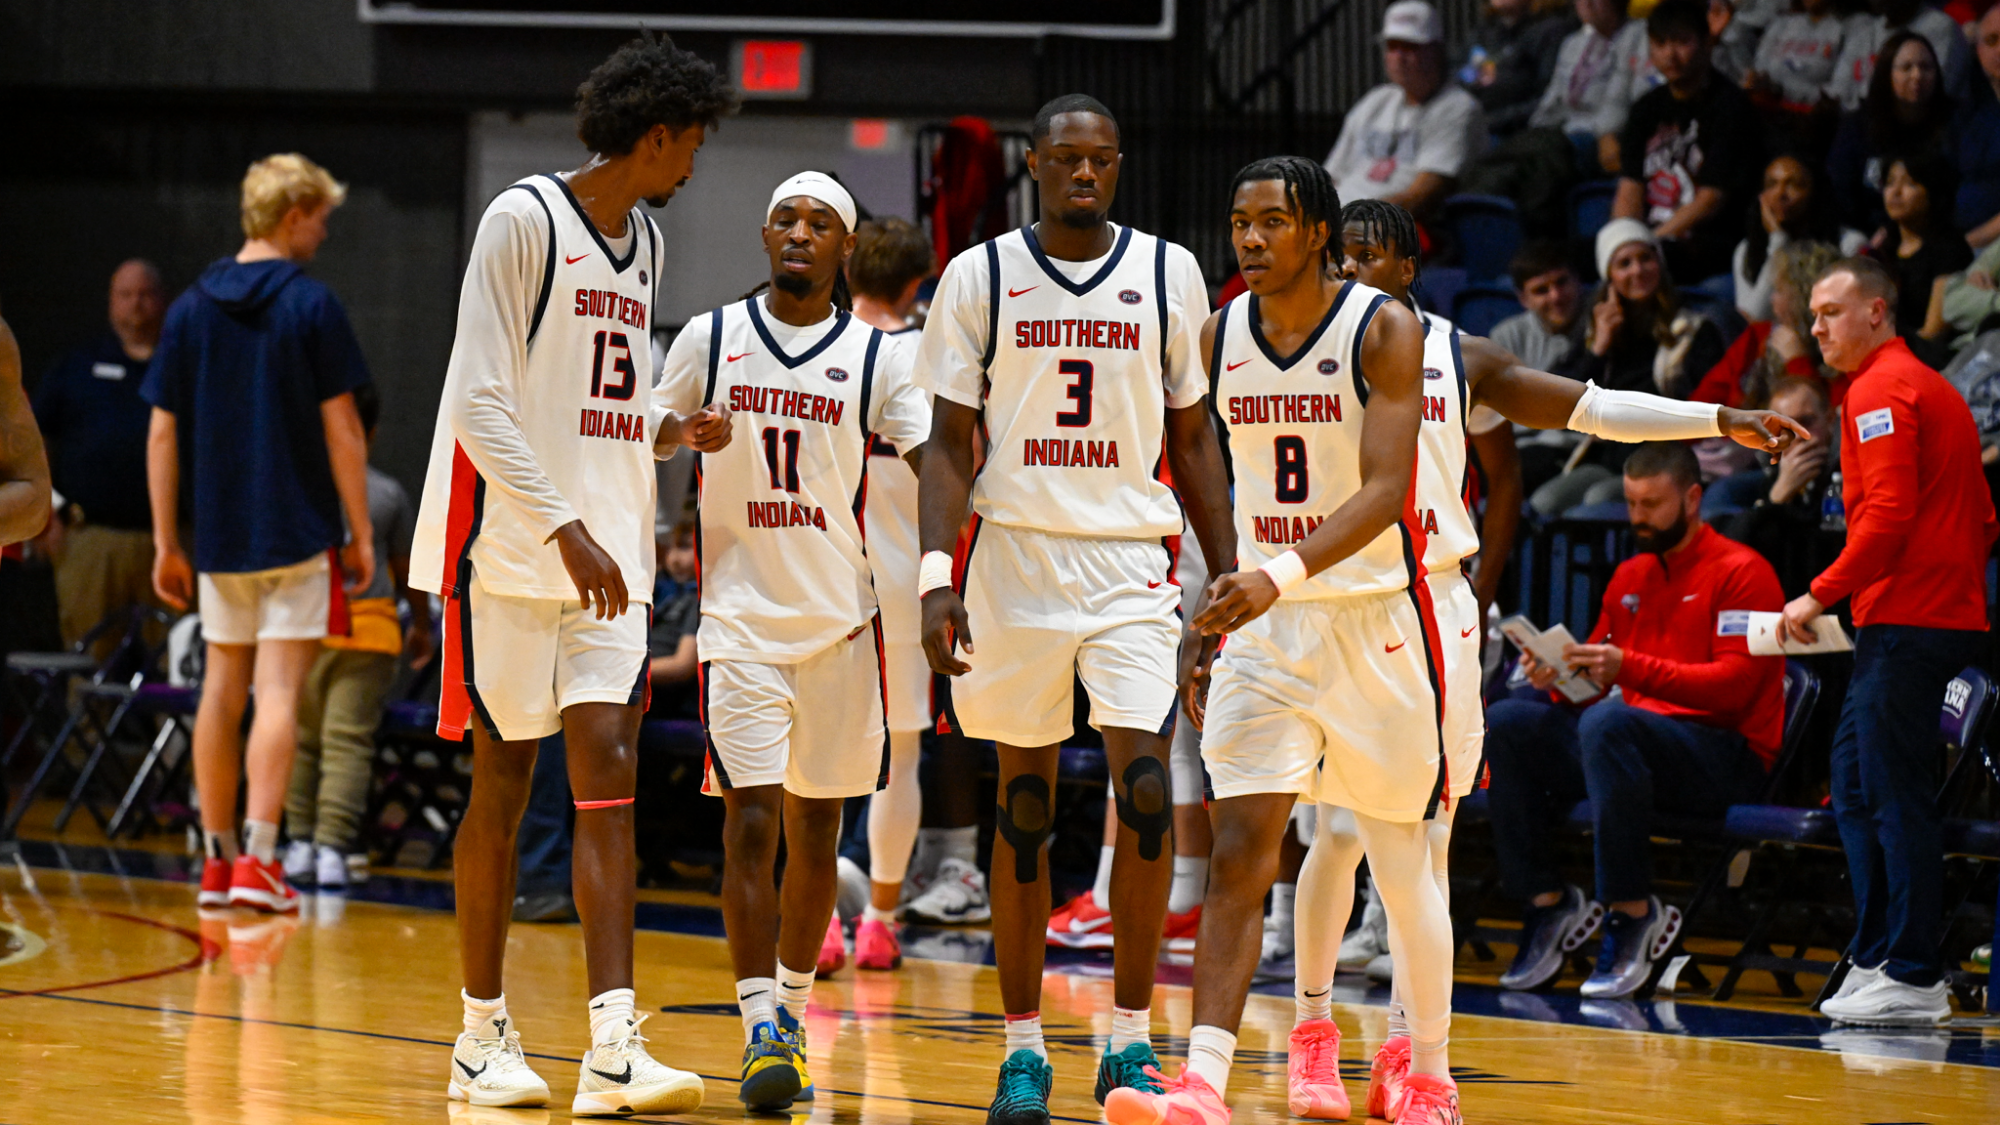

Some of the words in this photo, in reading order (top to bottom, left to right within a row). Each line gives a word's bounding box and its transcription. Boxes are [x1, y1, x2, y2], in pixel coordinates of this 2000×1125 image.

[1016, 319, 1140, 351] SOUTHERN
[590, 330, 637, 402] 13
[730, 385, 844, 426] SOUTHERN
[1056, 359, 1094, 428] 3
[1229, 394, 1342, 425] SOUTHERN
[580, 408, 644, 443] IDIANA
[762, 426, 801, 494] 11
[1023, 438, 1119, 468] INDIANA
[1273, 434, 1309, 504] 8
